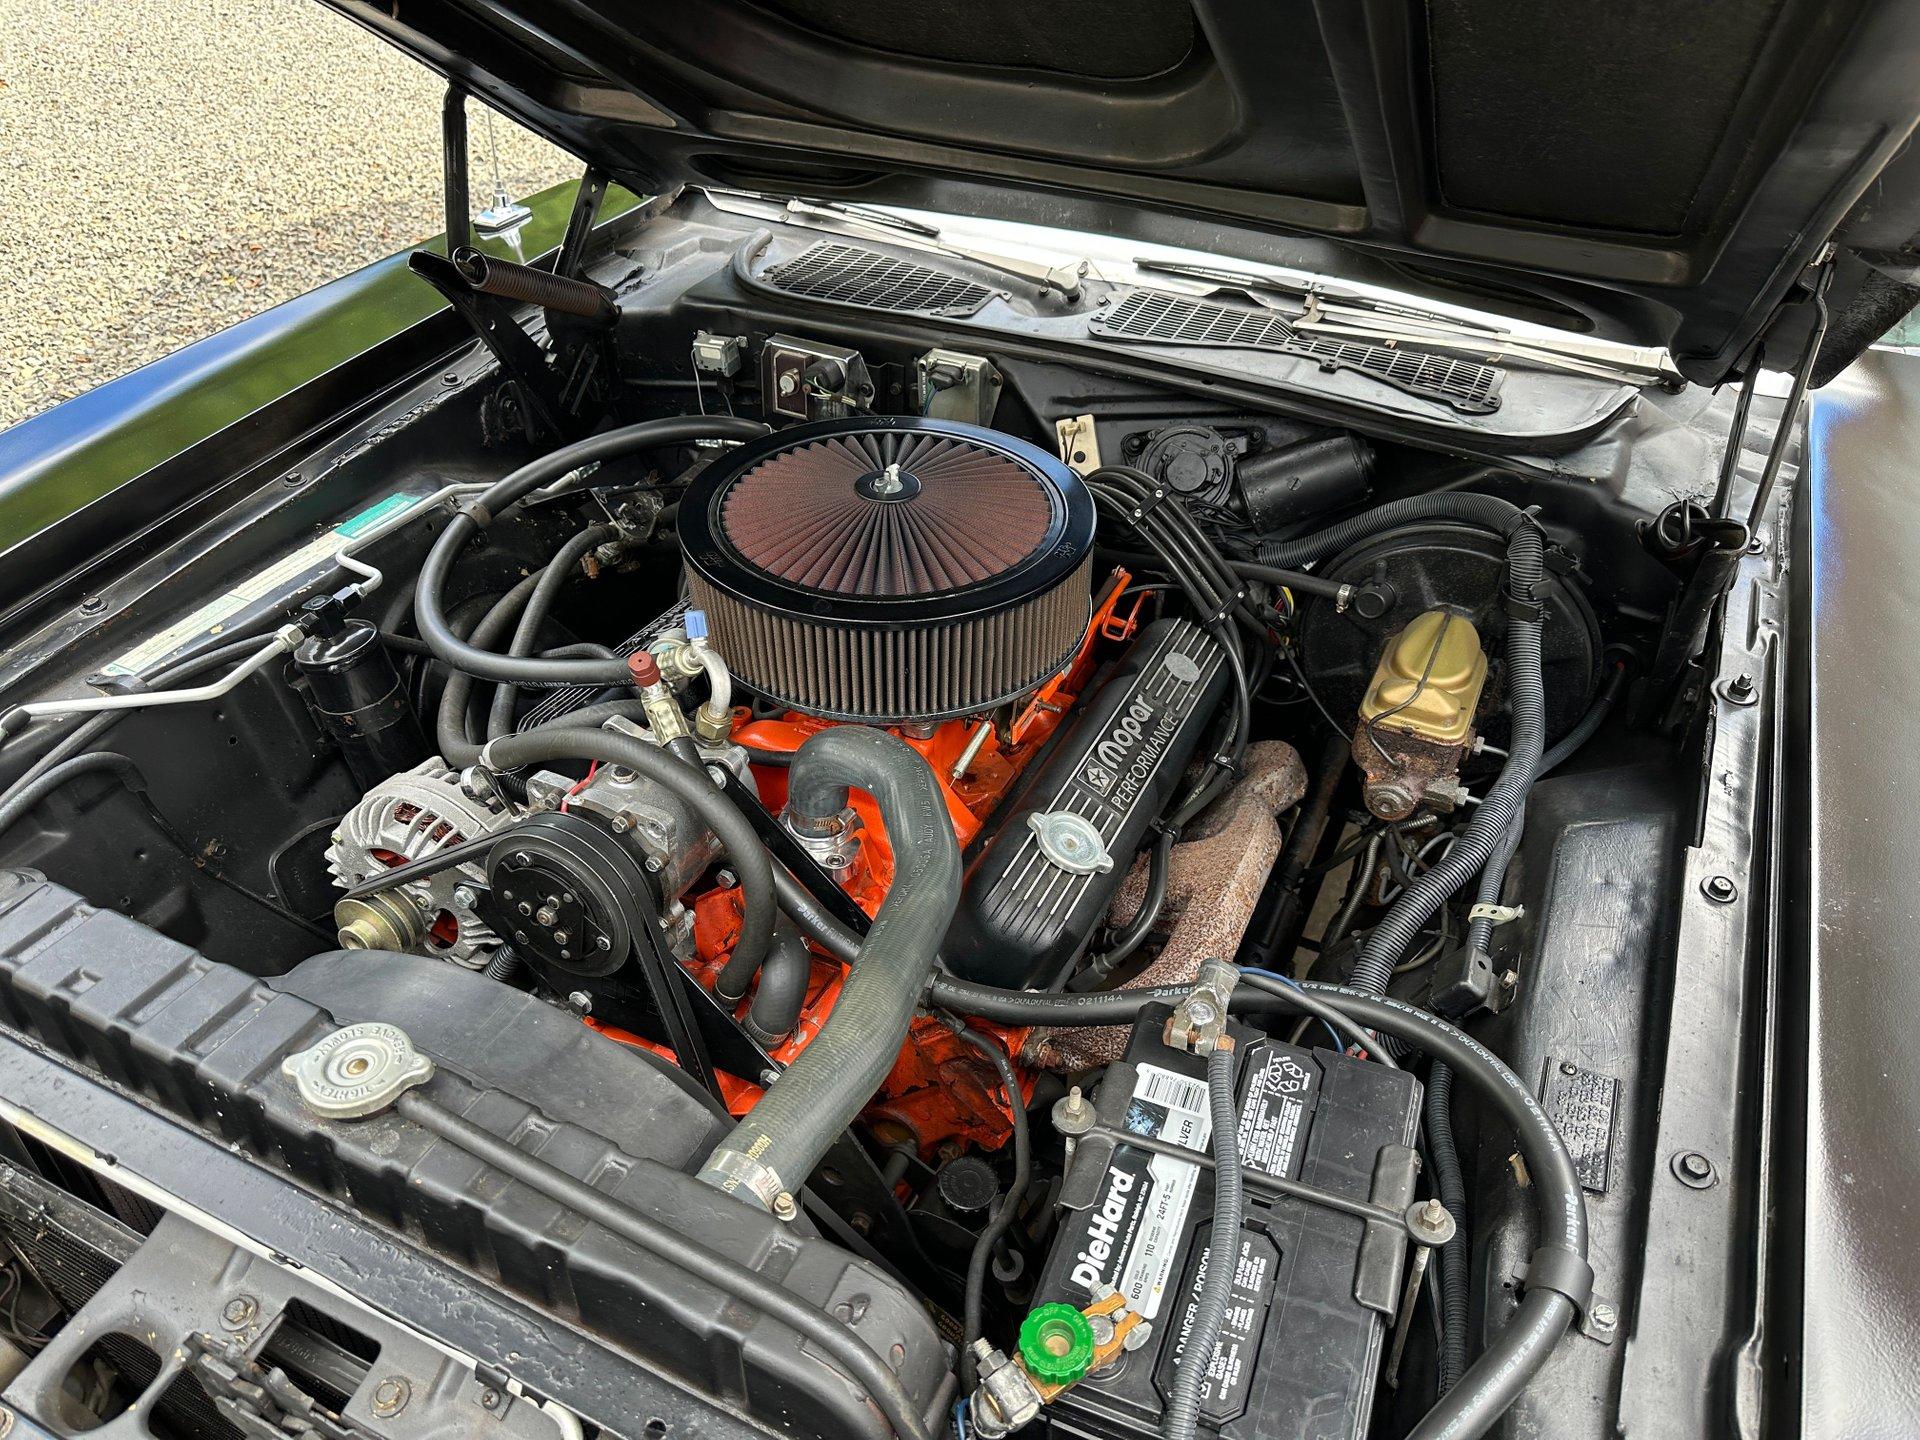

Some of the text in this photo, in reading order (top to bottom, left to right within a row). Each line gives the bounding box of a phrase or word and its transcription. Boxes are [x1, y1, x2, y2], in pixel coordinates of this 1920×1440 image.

[1097, 693, 1154, 769] Mopar
[1111, 710, 1179, 811] PERFORMANCE
[319, 1026, 365, 1056] SLOWLY
[317, 1084, 374, 1101] TIGHTEN
[1155, 1192, 1171, 1220] 24FT-5
[1564, 1192, 1581, 1241] Parker
[1071, 1166, 1135, 1290] DieHard
[1143, 1242, 1156, 1257] 110
[1240, 1240, 1251, 1257] ACID
[1155, 1255, 1170, 1286] WARNING:
[1129, 1281, 1143, 1300] 600
[1214, 1355, 1228, 1380] GASES
